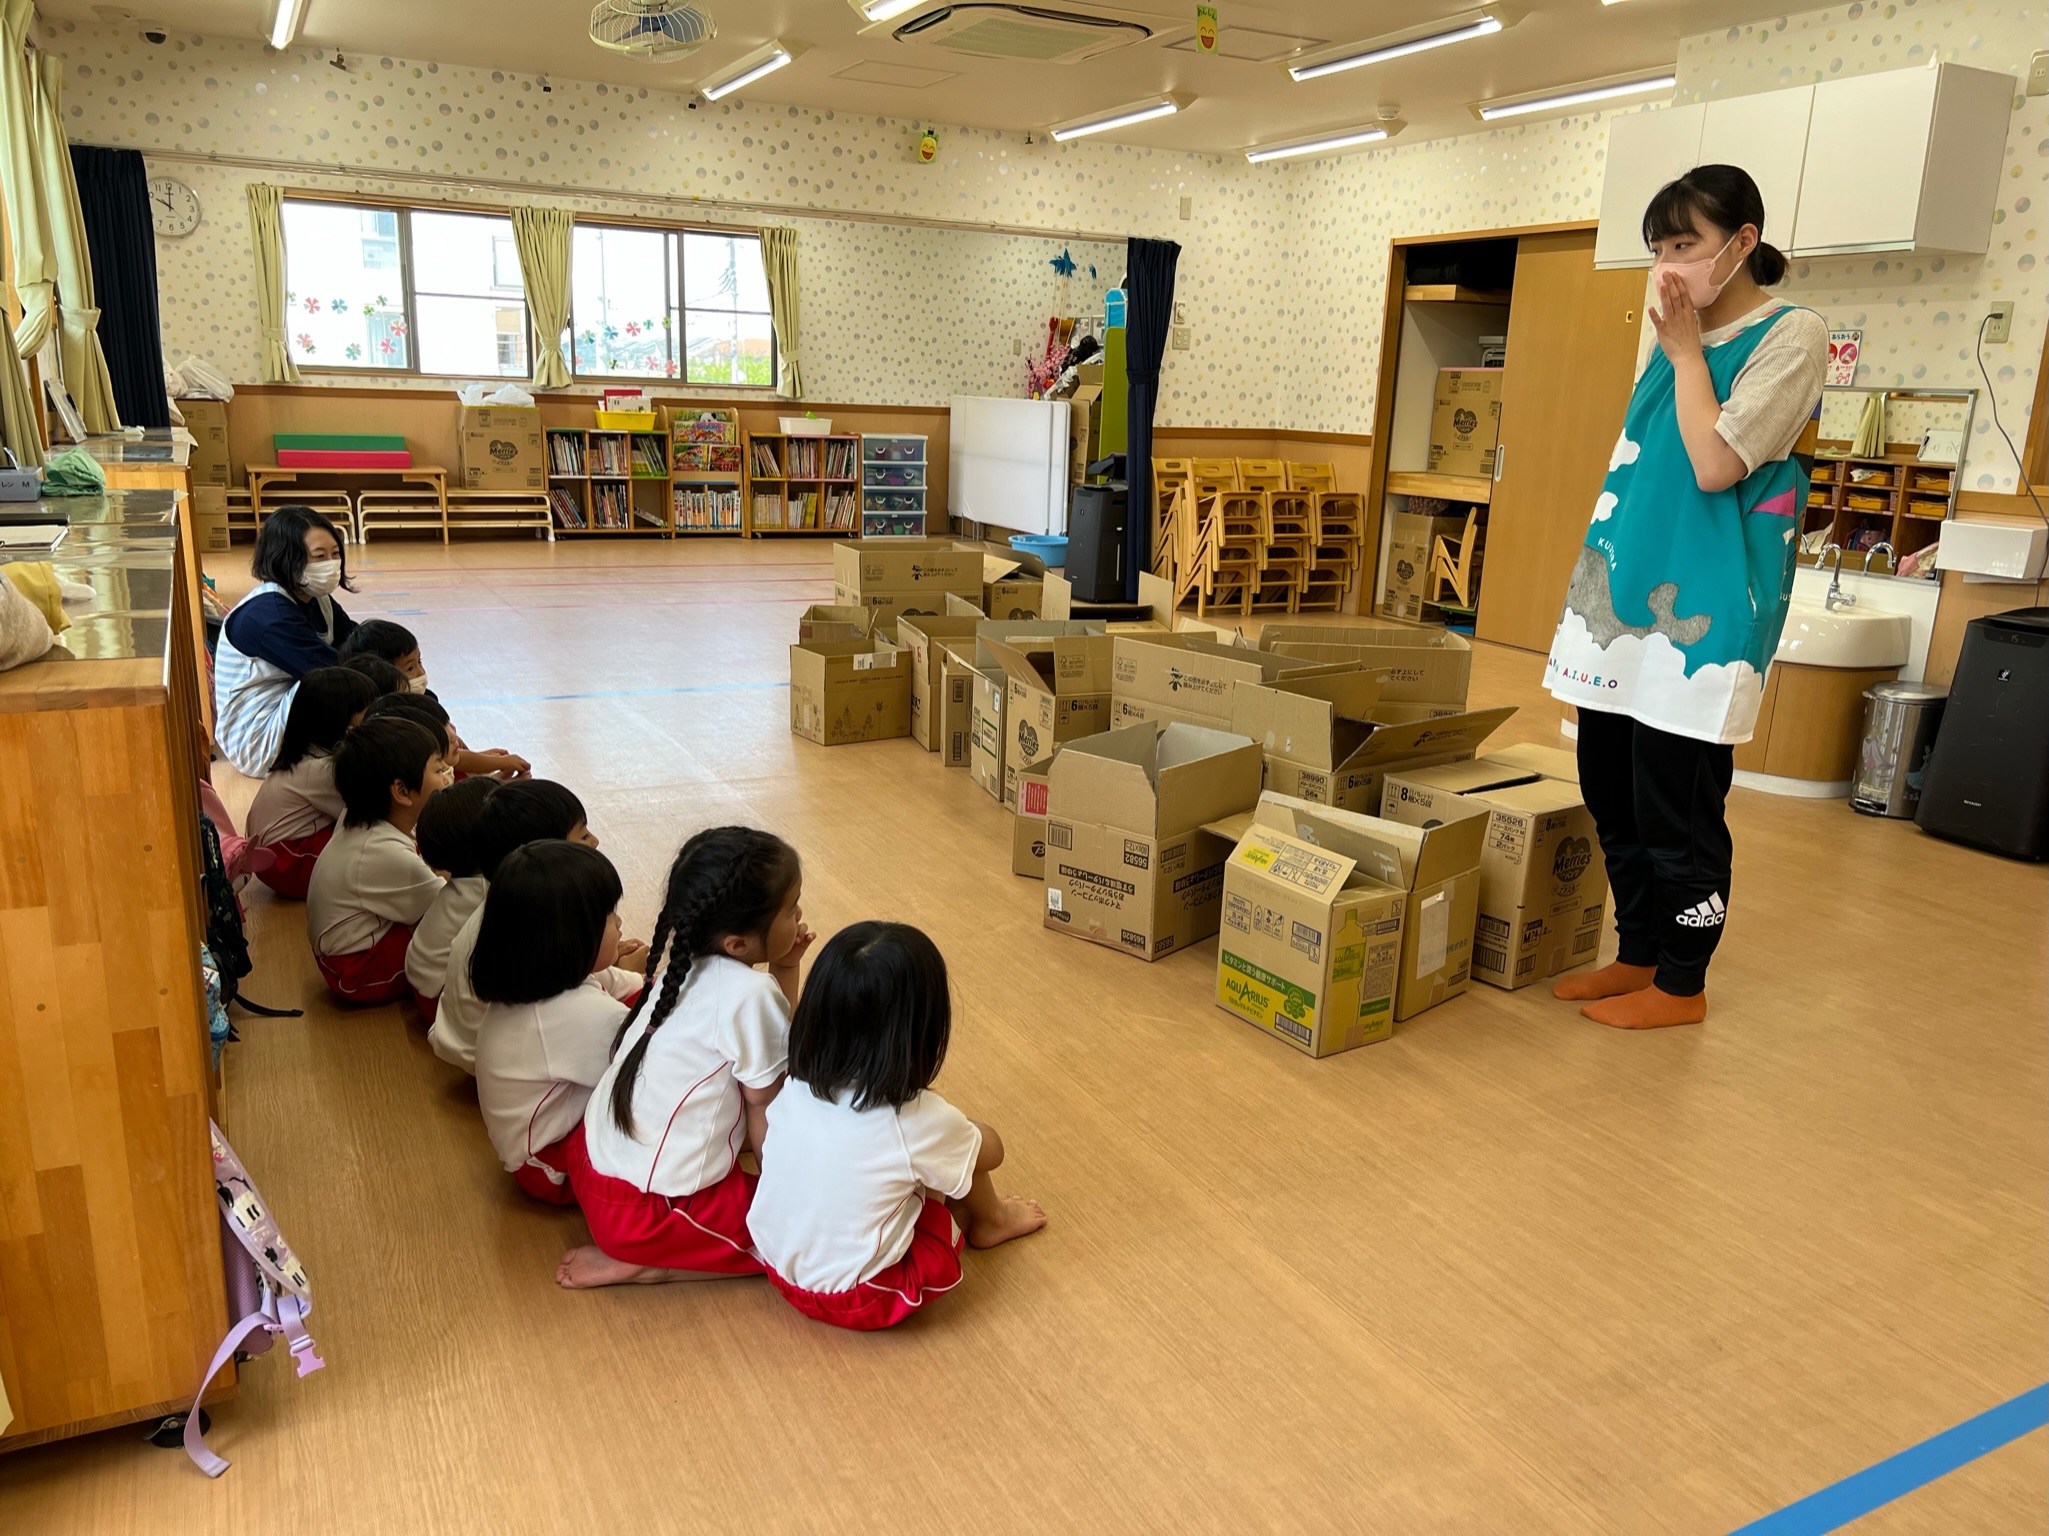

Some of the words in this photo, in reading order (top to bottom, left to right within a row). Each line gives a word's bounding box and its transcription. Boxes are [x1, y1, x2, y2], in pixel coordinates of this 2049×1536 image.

[155, 184, 161, 192] 11
[169, 223, 174, 231] 6
[1071, 699, 1078, 711] 6
[1122, 703, 1128, 715] 6
[1301, 771, 1325, 784] 38990
[1348, 776, 1354, 789] 6
[1401, 787, 1408, 801] 8
[1496, 813, 1524, 827] 35526
[1546, 818, 1551, 832] 8
[1125, 853, 1148, 868] 56582
[1552, 849, 1592, 877] Merries
[1071, 889, 1121, 910] マイクポップコーン
[1676, 912, 1725, 927] adida
[1123, 930, 1145, 945] 565820
[1224, 953, 1286, 991] ビタミンと潤う健康サポート
[1226, 978, 1269, 1009] AQUARIUS
